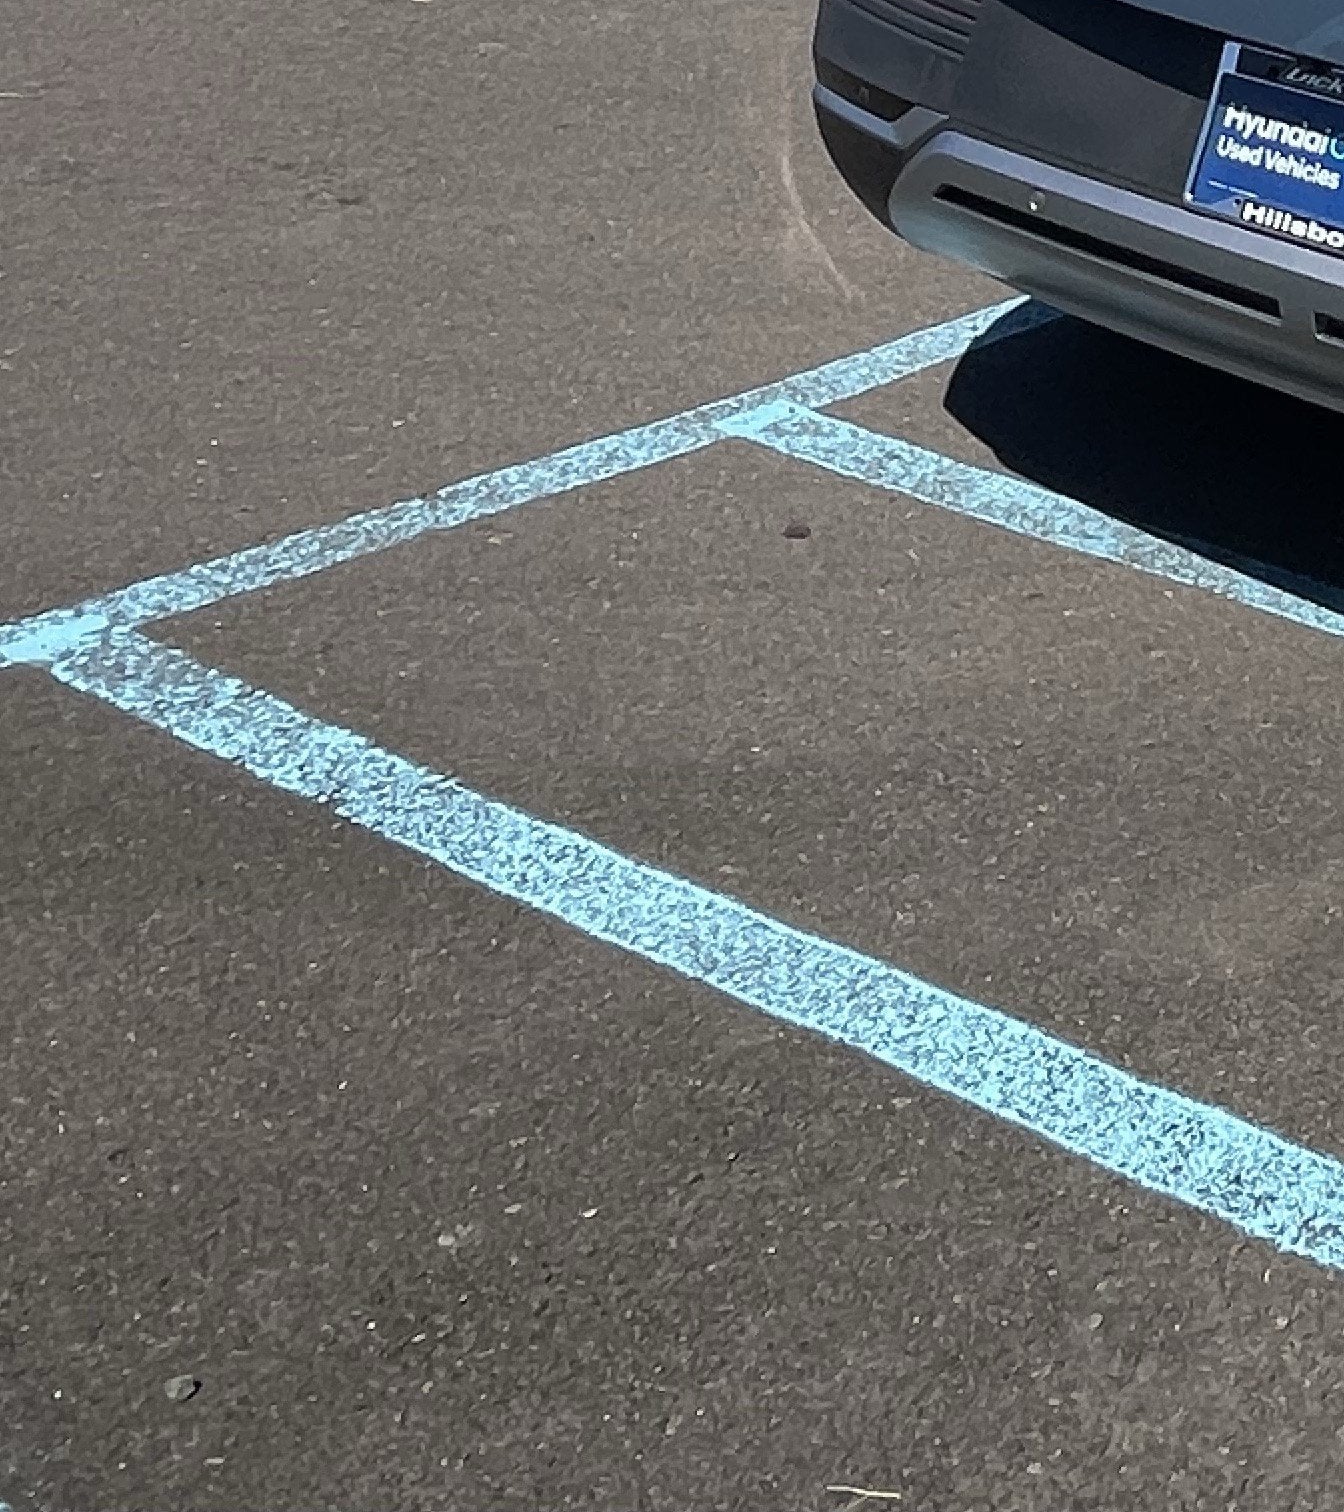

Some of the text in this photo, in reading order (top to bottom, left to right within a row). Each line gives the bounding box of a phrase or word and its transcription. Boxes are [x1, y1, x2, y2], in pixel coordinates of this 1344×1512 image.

[1223, 102, 1332, 155] Hyundai
[1216, 135, 1342, 190] Used Vehicles
